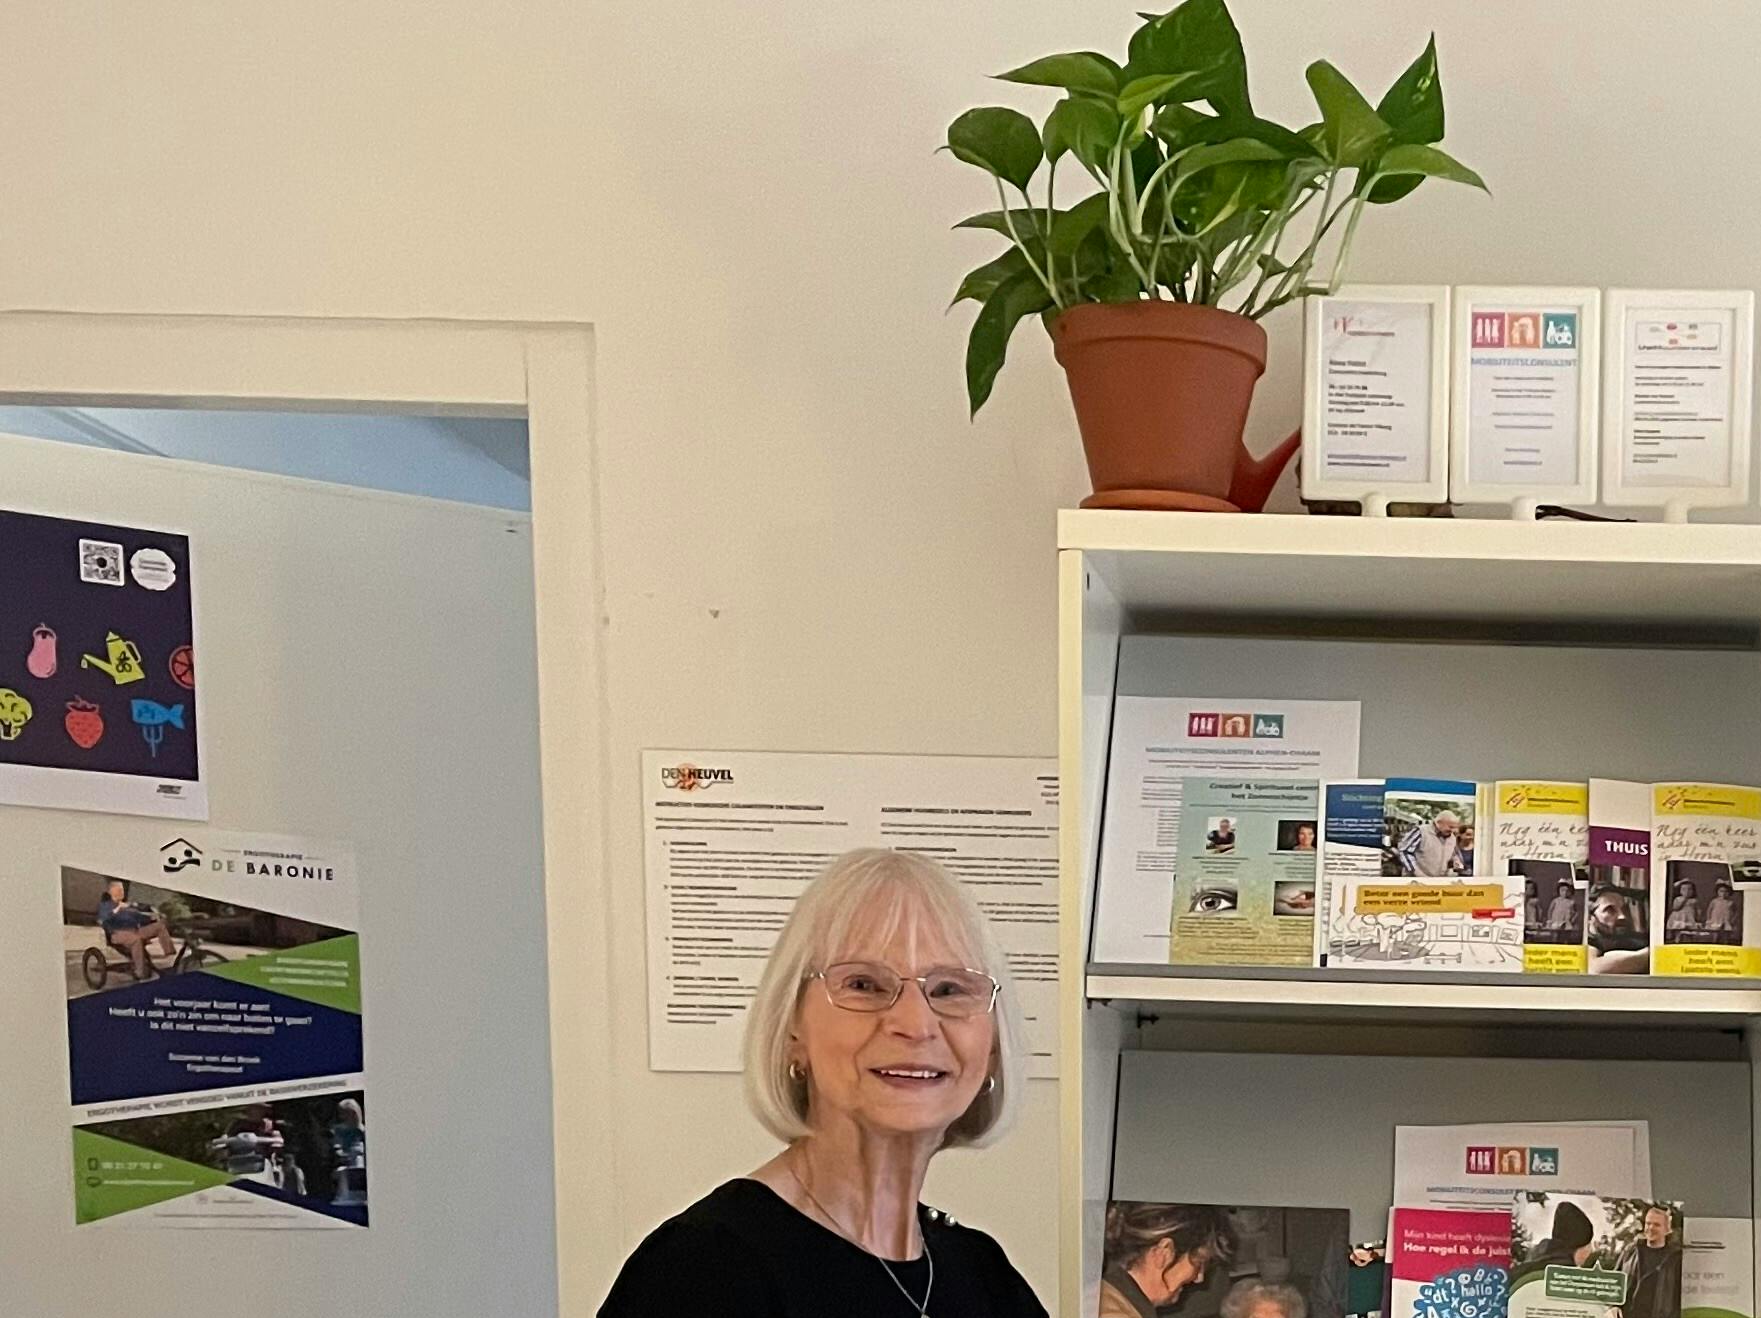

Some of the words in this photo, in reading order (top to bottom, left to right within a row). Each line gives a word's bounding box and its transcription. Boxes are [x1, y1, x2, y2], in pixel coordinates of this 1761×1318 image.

[1604, 839, 1650, 856] THUIS
[211, 859, 237, 874] DE
[245, 862, 335, 881] BARONIE
